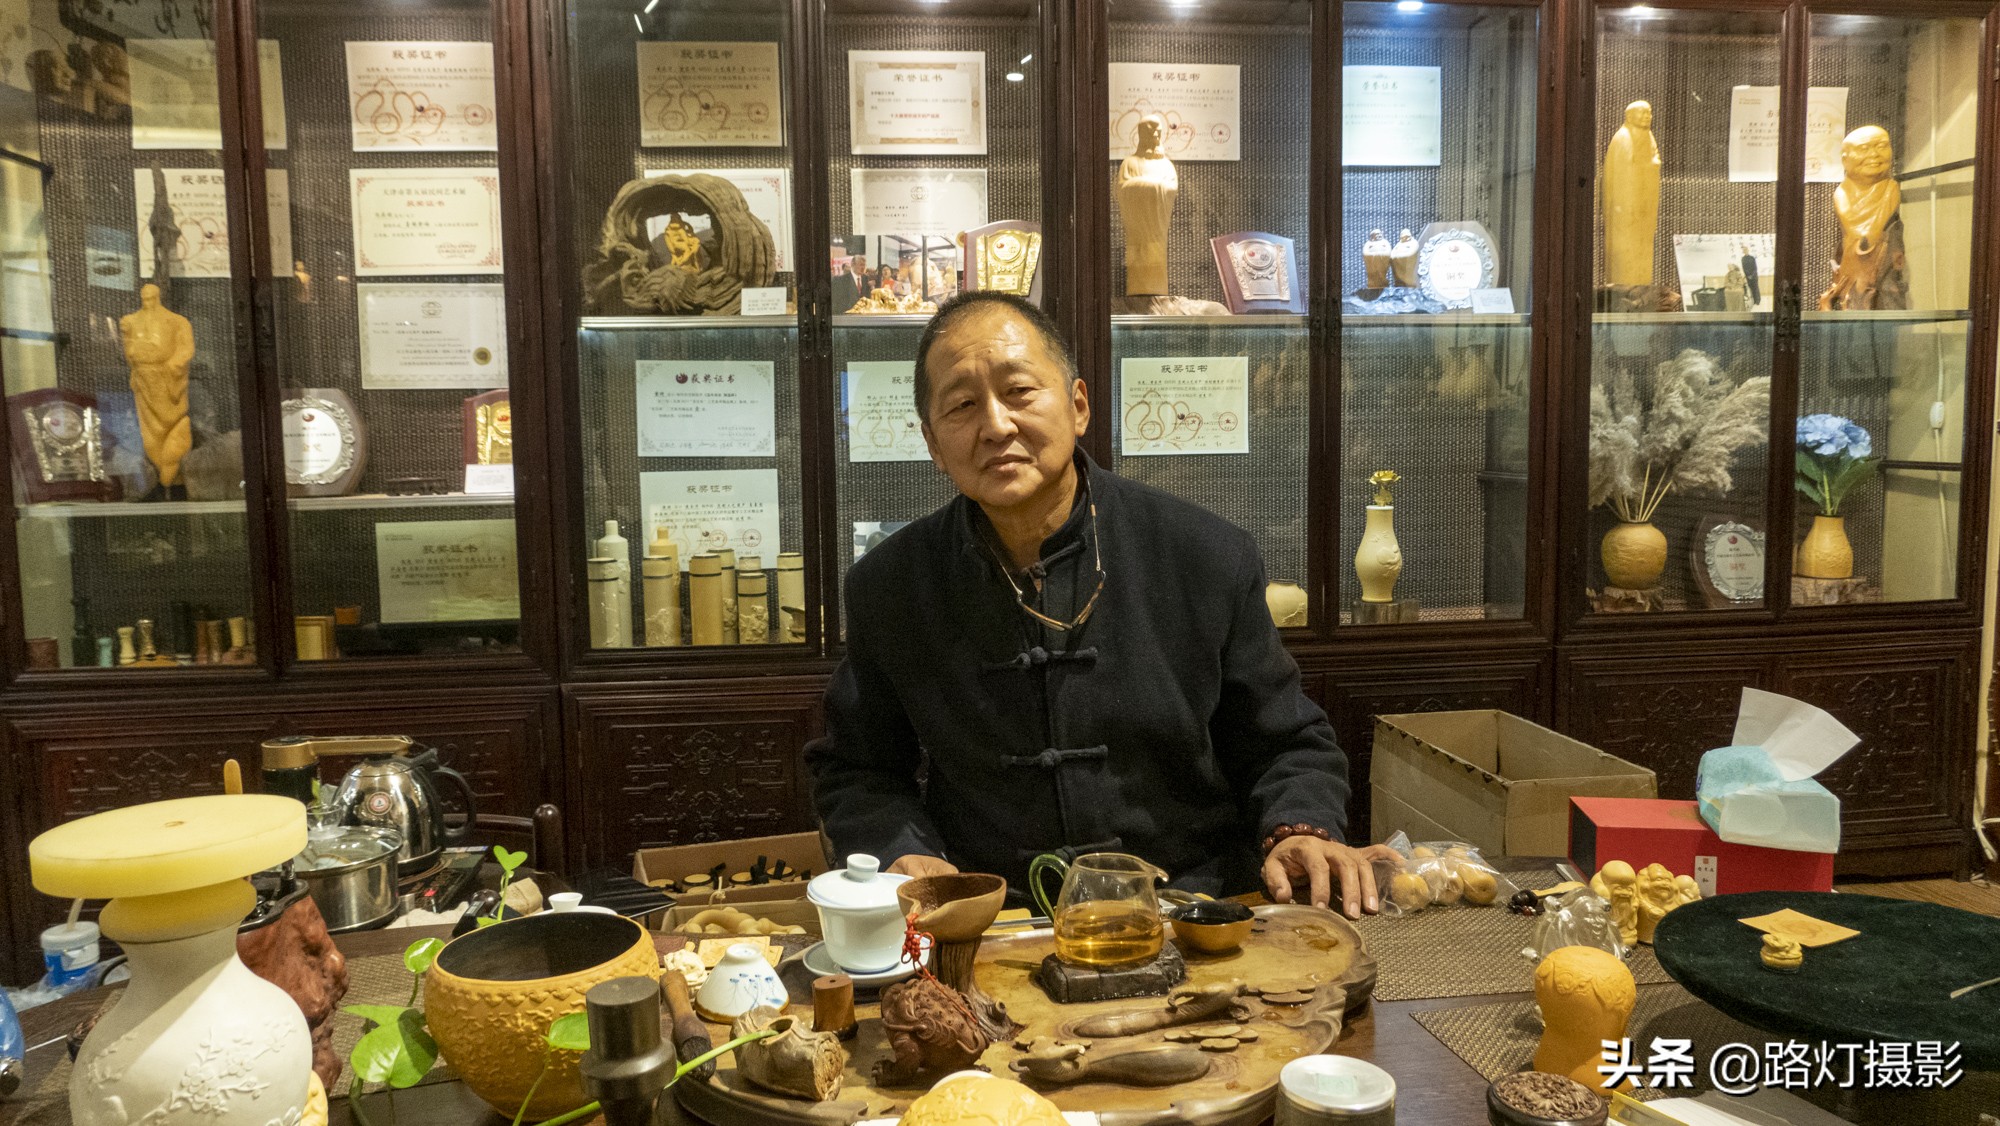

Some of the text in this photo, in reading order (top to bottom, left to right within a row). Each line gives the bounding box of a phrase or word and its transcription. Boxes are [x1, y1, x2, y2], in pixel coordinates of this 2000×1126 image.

[1160, 364, 1208, 374] 获奖证书
[691, 373, 735, 384] 获奖证书
[686, 485, 733, 494] 获奖证书
